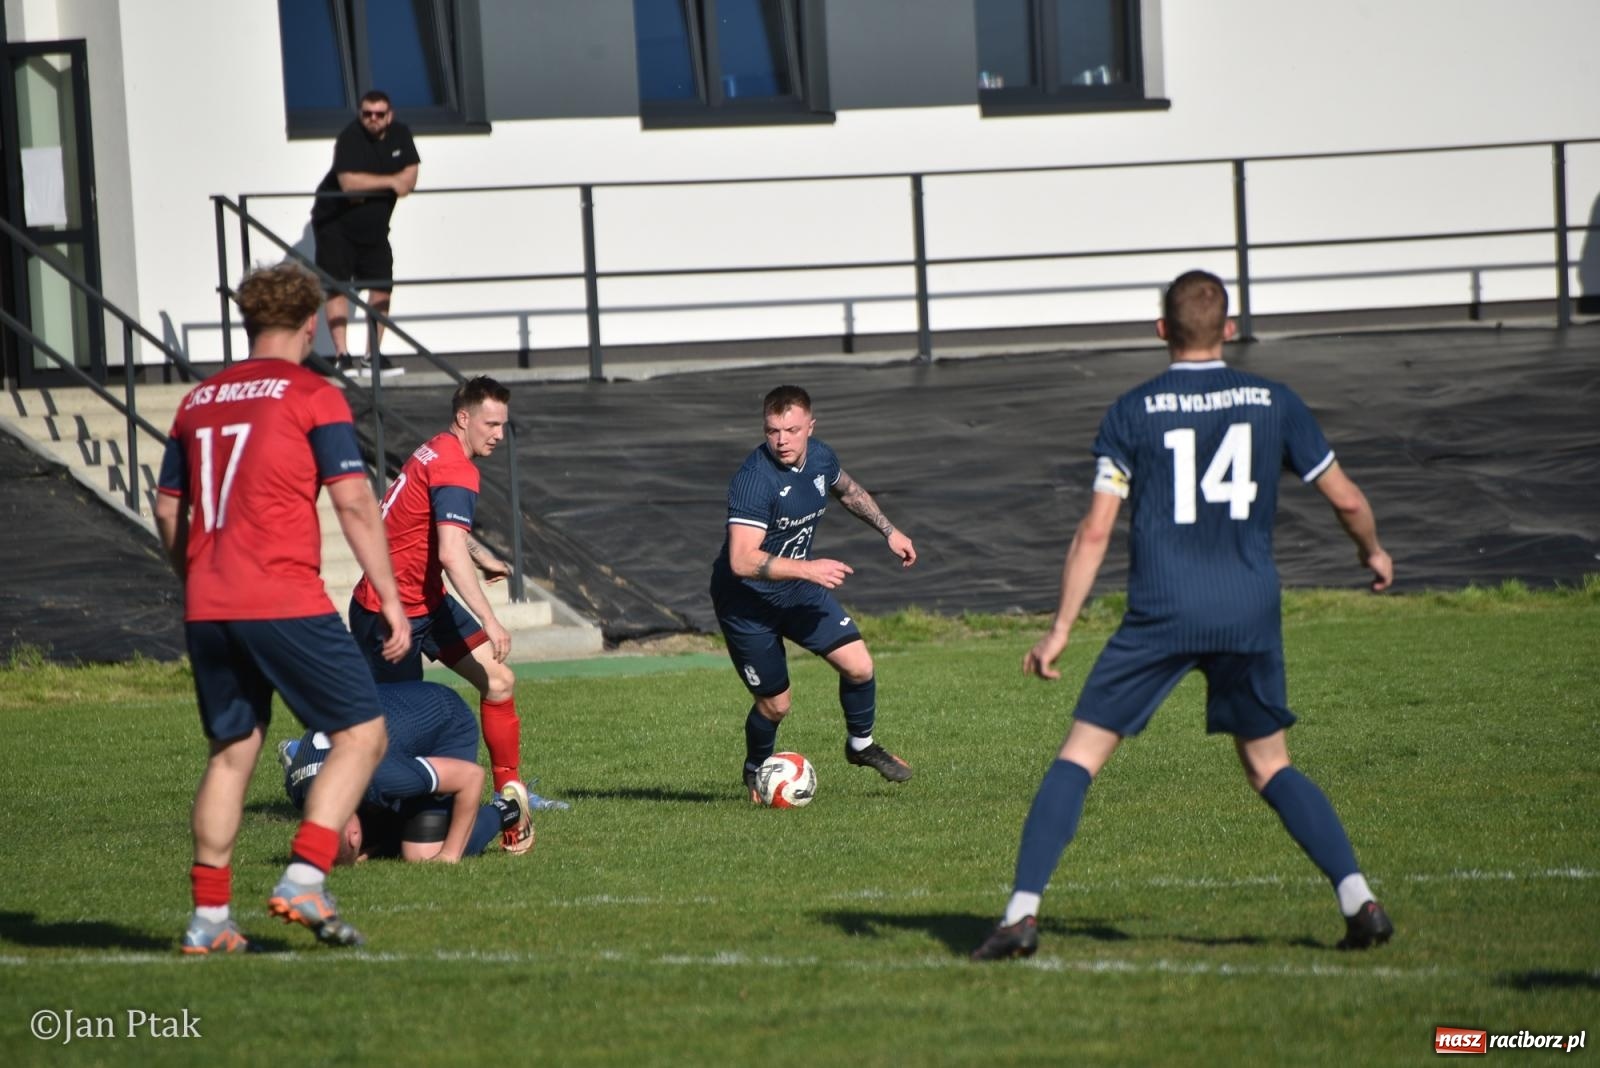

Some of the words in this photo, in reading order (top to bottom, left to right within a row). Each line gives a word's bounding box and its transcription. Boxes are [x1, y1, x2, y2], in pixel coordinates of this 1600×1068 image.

[214, 378, 291, 403] BRZEZIE
[195, 422, 252, 533] 17
[1163, 422, 1258, 524] 14
